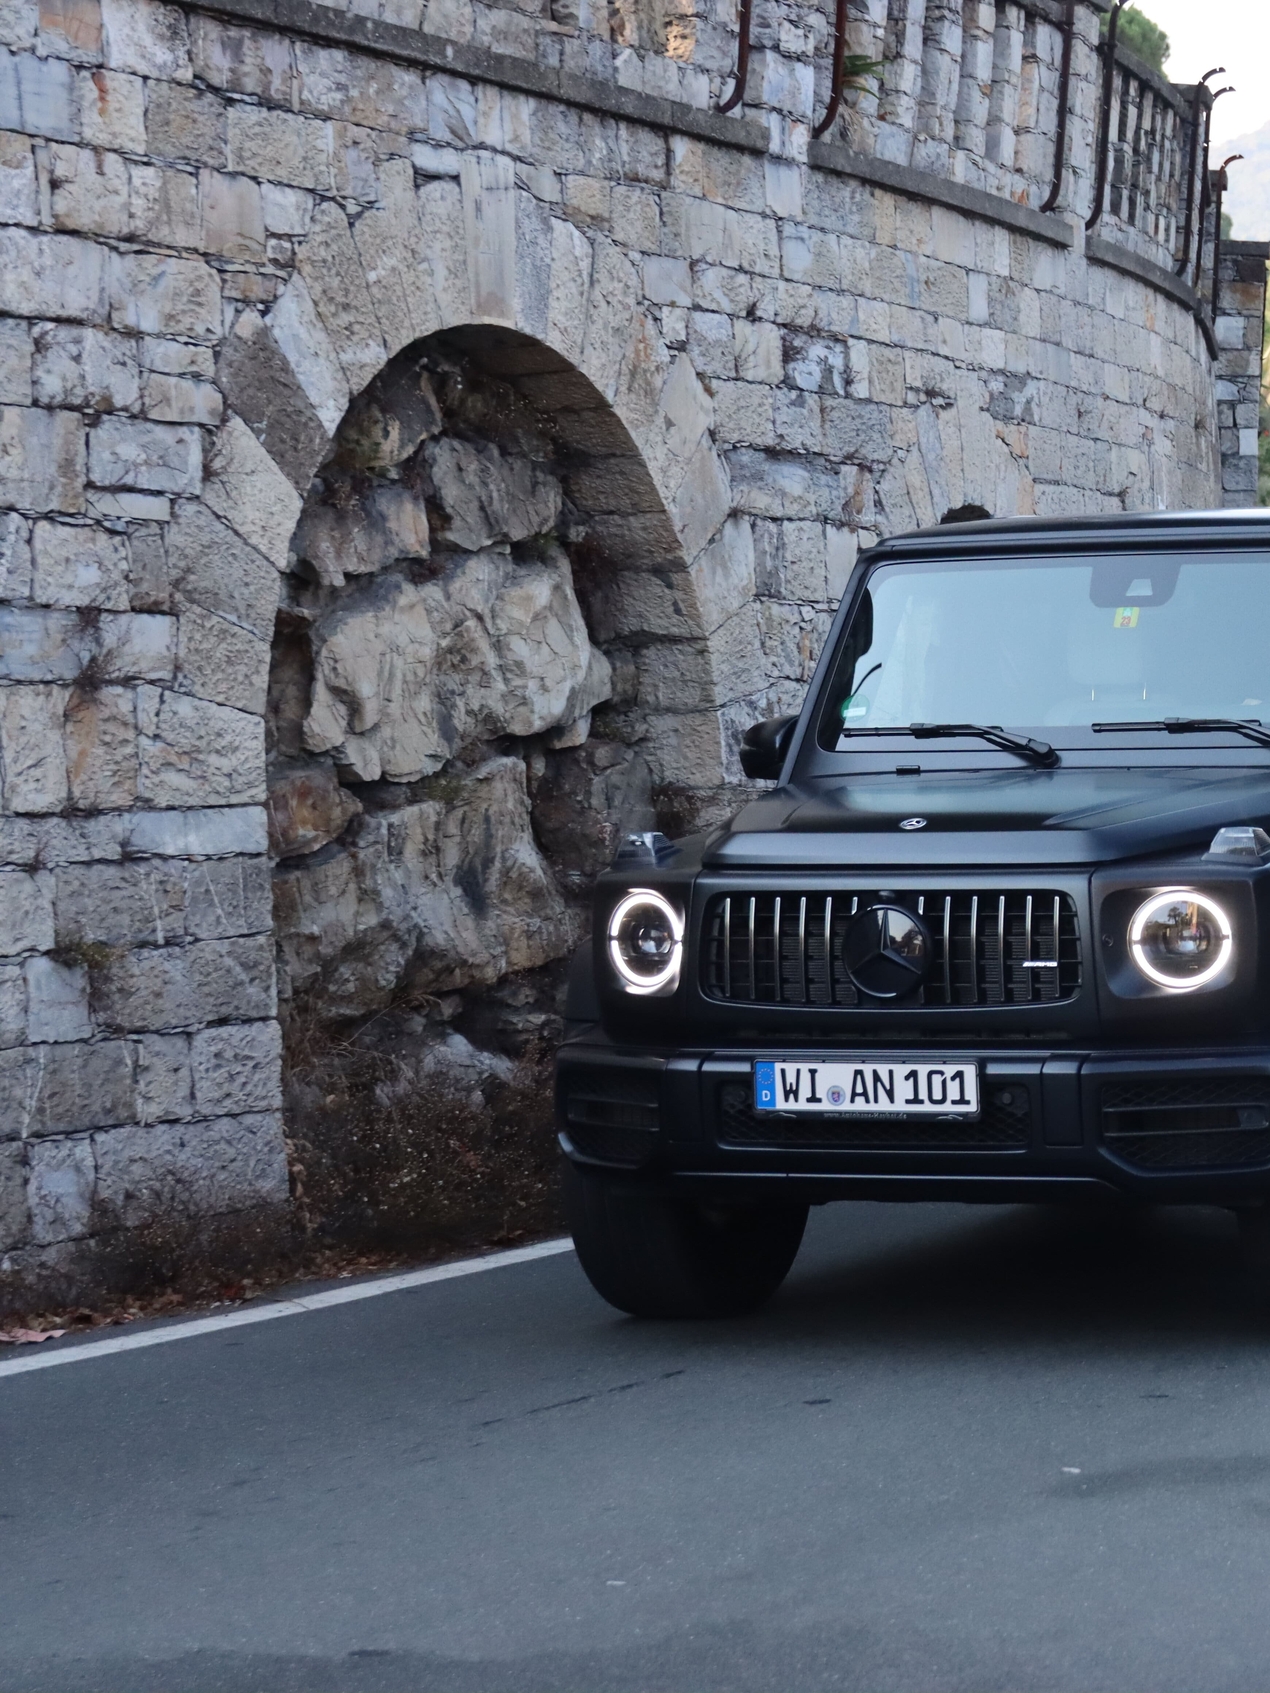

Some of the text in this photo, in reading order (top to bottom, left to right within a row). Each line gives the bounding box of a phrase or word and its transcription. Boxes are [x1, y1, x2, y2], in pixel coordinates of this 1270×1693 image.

[762, 1068, 971, 1105] D WI AN 101
